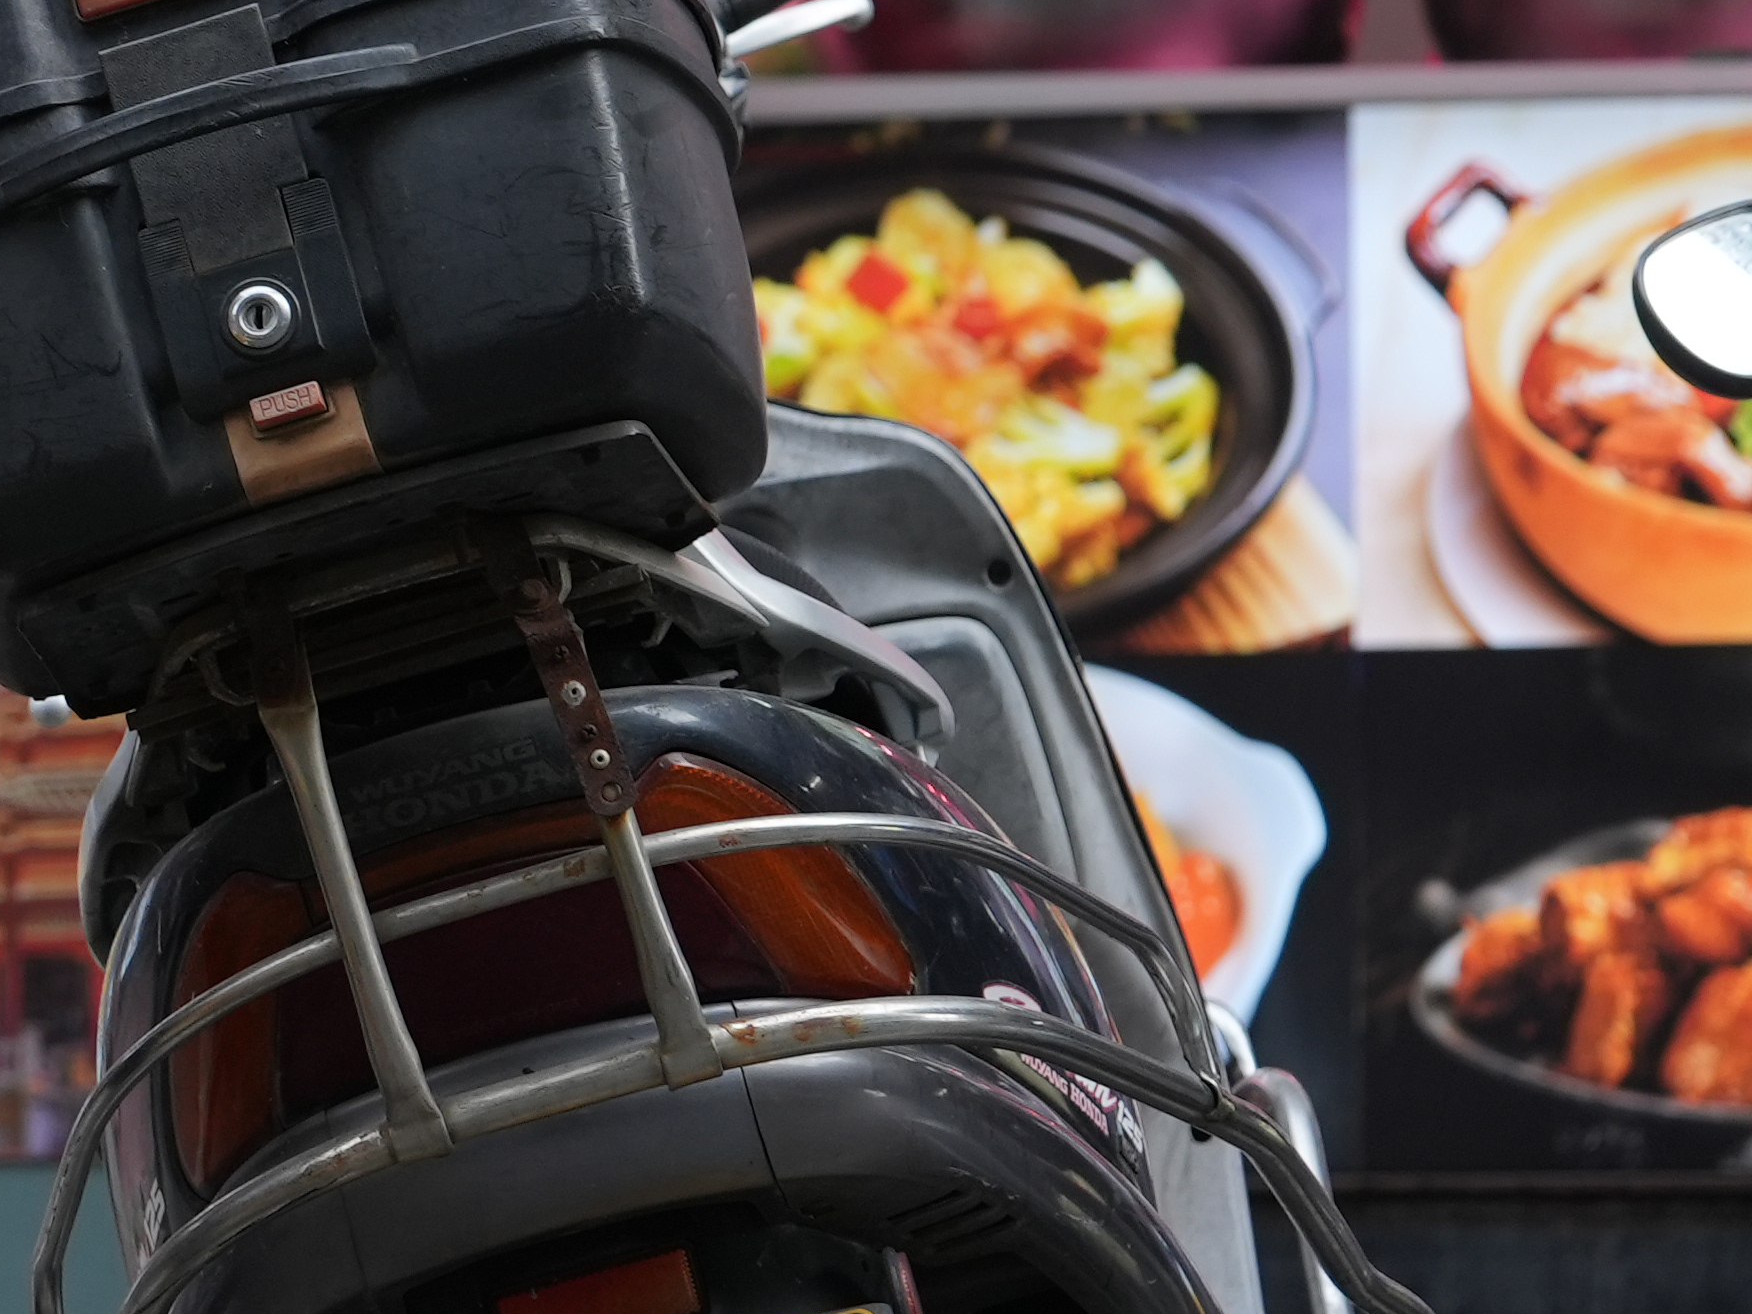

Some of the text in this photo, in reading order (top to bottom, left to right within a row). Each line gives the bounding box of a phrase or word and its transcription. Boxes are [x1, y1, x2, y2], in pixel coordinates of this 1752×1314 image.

[258, 385, 313, 418] PUSH
[344, 758, 565, 835] HONDA
[348, 738, 538, 804] WUYANG
[1069, 1082, 1110, 1138] HONDA
[1116, 1098, 1144, 1155] 125
